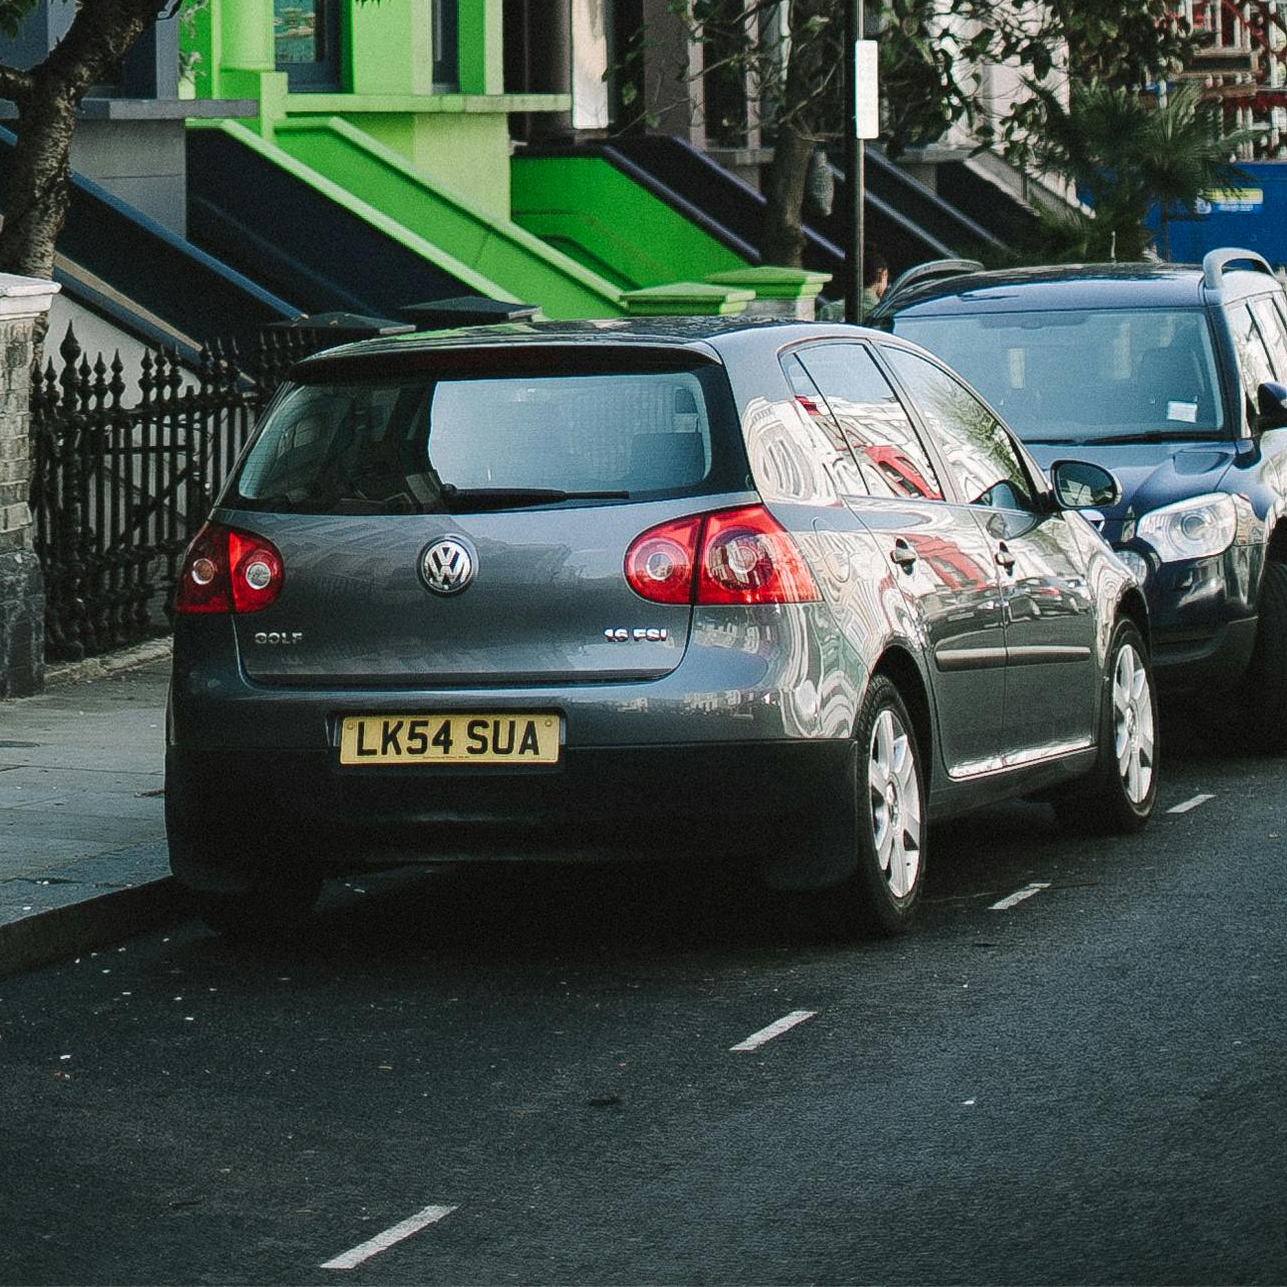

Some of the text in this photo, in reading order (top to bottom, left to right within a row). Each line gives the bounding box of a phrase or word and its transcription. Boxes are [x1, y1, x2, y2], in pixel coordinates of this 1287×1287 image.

[633, 628, 667, 642] FSI
[356, 719, 540, 756] LK54 SUA
